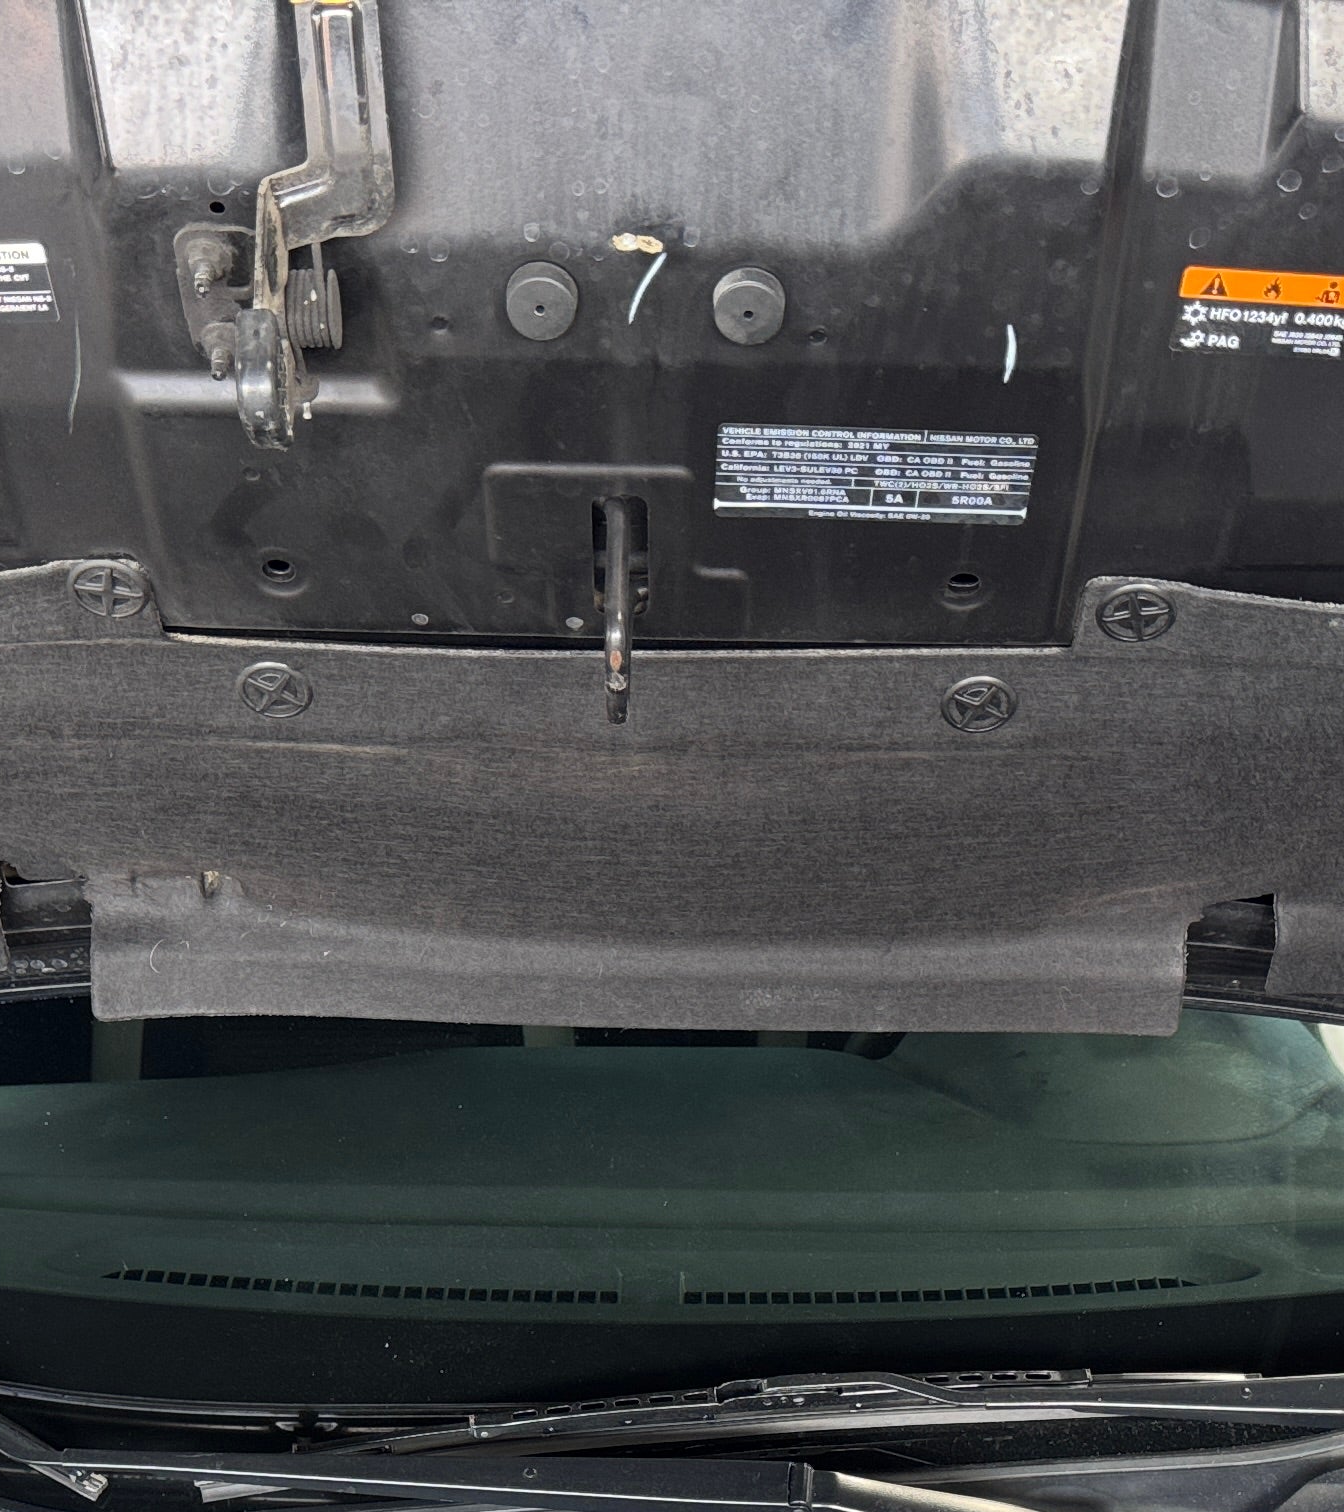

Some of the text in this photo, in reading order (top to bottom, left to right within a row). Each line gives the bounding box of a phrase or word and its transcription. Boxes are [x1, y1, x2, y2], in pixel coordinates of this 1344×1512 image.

[13, 274, 30, 282] CVT
[1207, 334, 1240, 349] PAG
[722, 427, 921, 442] VEHICLE EMISSION CONTROL INFORMATION
[930, 434, 963, 442] NISSAN
[966, 435, 997, 443] MOTOR
[722, 437, 769, 446] Conforms
[772, 439, 782, 447] to
[784, 440, 843, 449] regulations:
[721, 450, 741, 458] U.S.
[744, 451, 767, 459] EPA:
[961, 459, 986, 467] Fuel:
[990, 459, 1031, 468] Gasoline
[720, 463, 770, 472] California:
[845, 467, 859, 475] PC
[989, 473, 1029, 481] Gasoline
